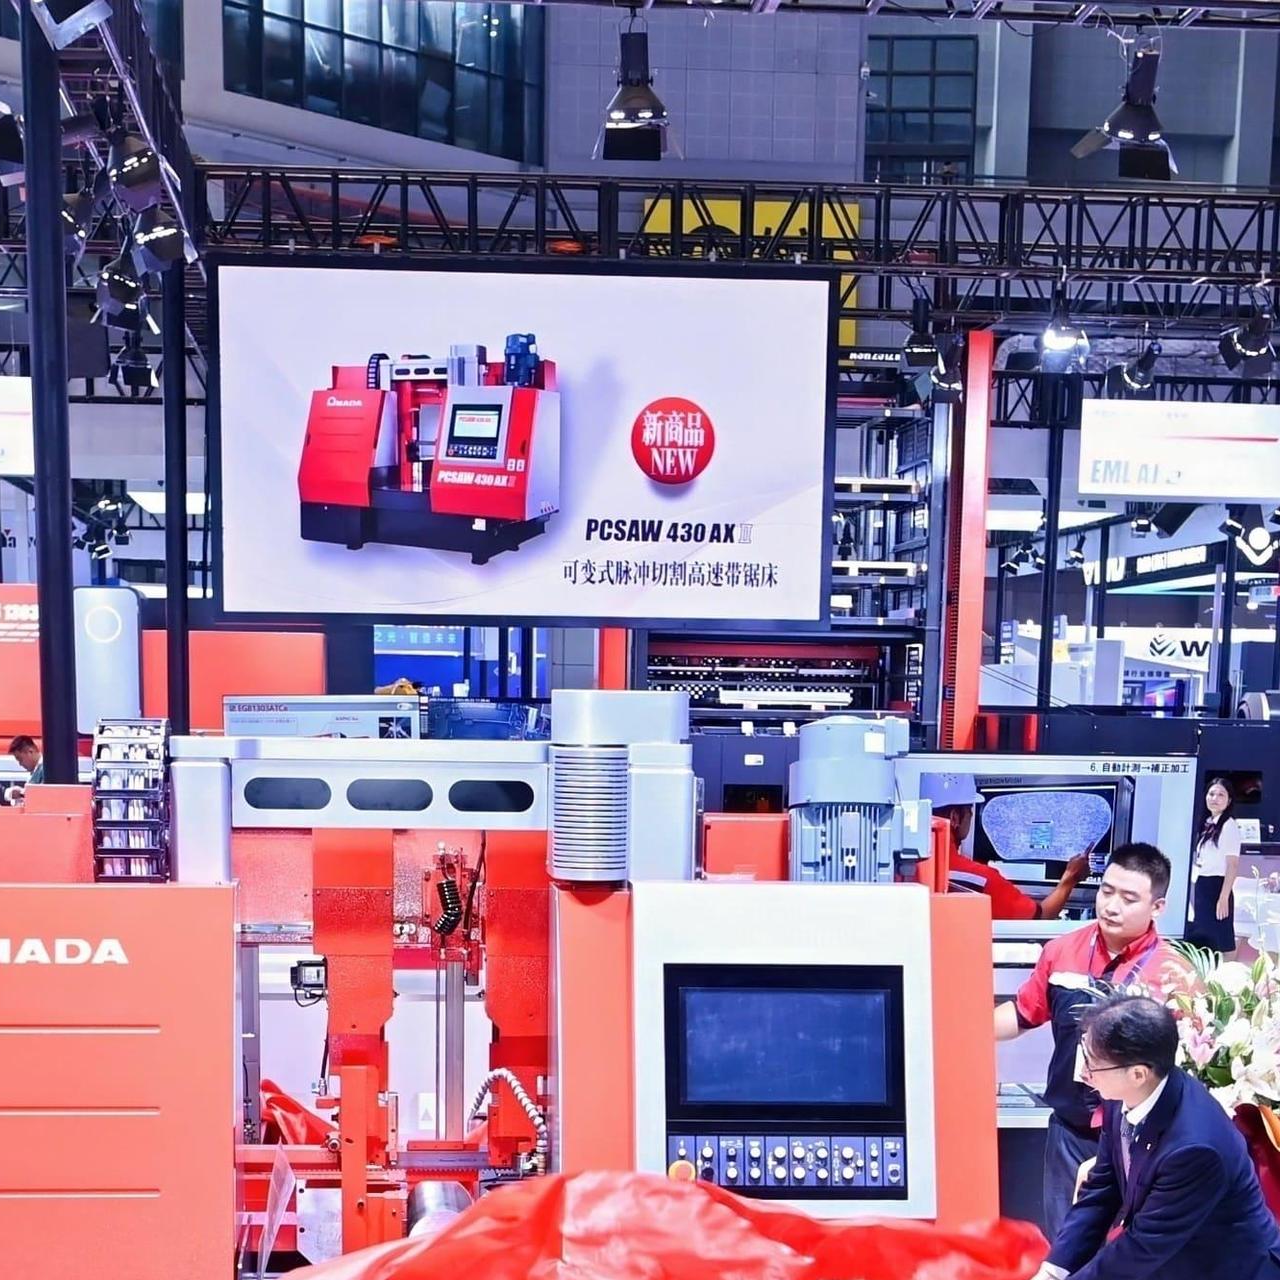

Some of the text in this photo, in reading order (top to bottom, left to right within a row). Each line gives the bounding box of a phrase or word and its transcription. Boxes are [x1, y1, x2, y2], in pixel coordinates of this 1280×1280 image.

[642, 410, 705, 447] 新商品
[651, 447, 698, 476] NEW
[437, 470, 475, 484] PCSAW
[475, 473, 493, 485] 430
[585, 518, 663, 542] PCSAW
[666, 522, 706, 543] 430
[709, 523, 736, 543] AX
[562, 559, 779, 588] 可变式脉冲切割高速带锯床
